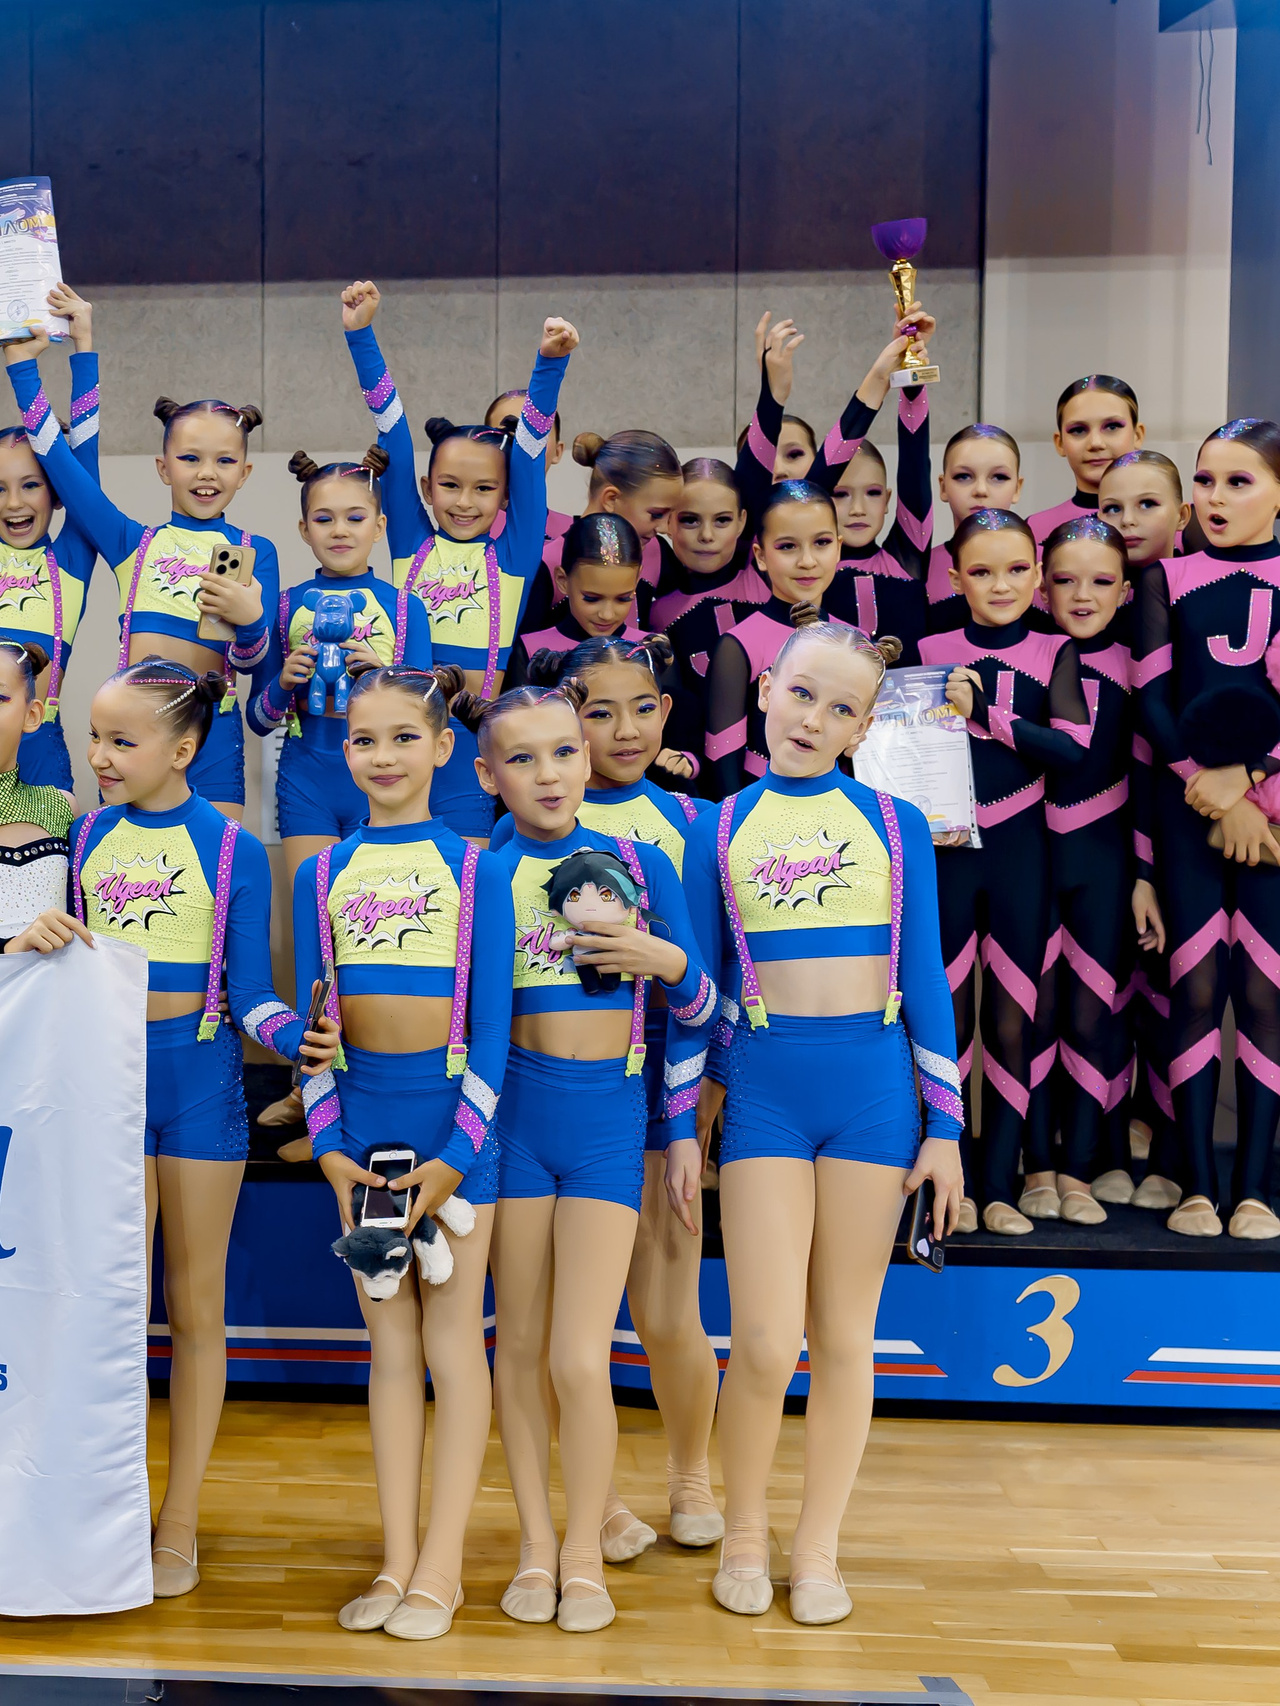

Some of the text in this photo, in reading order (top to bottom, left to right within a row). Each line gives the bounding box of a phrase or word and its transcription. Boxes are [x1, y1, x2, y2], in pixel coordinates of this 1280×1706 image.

[1207, 588, 1273, 666] J
[95, 873, 173, 914] Идеал
[750, 850, 843, 895] Идеал
[340, 892, 428, 934] Идеал
[992, 1274, 1080, 1387] 3
